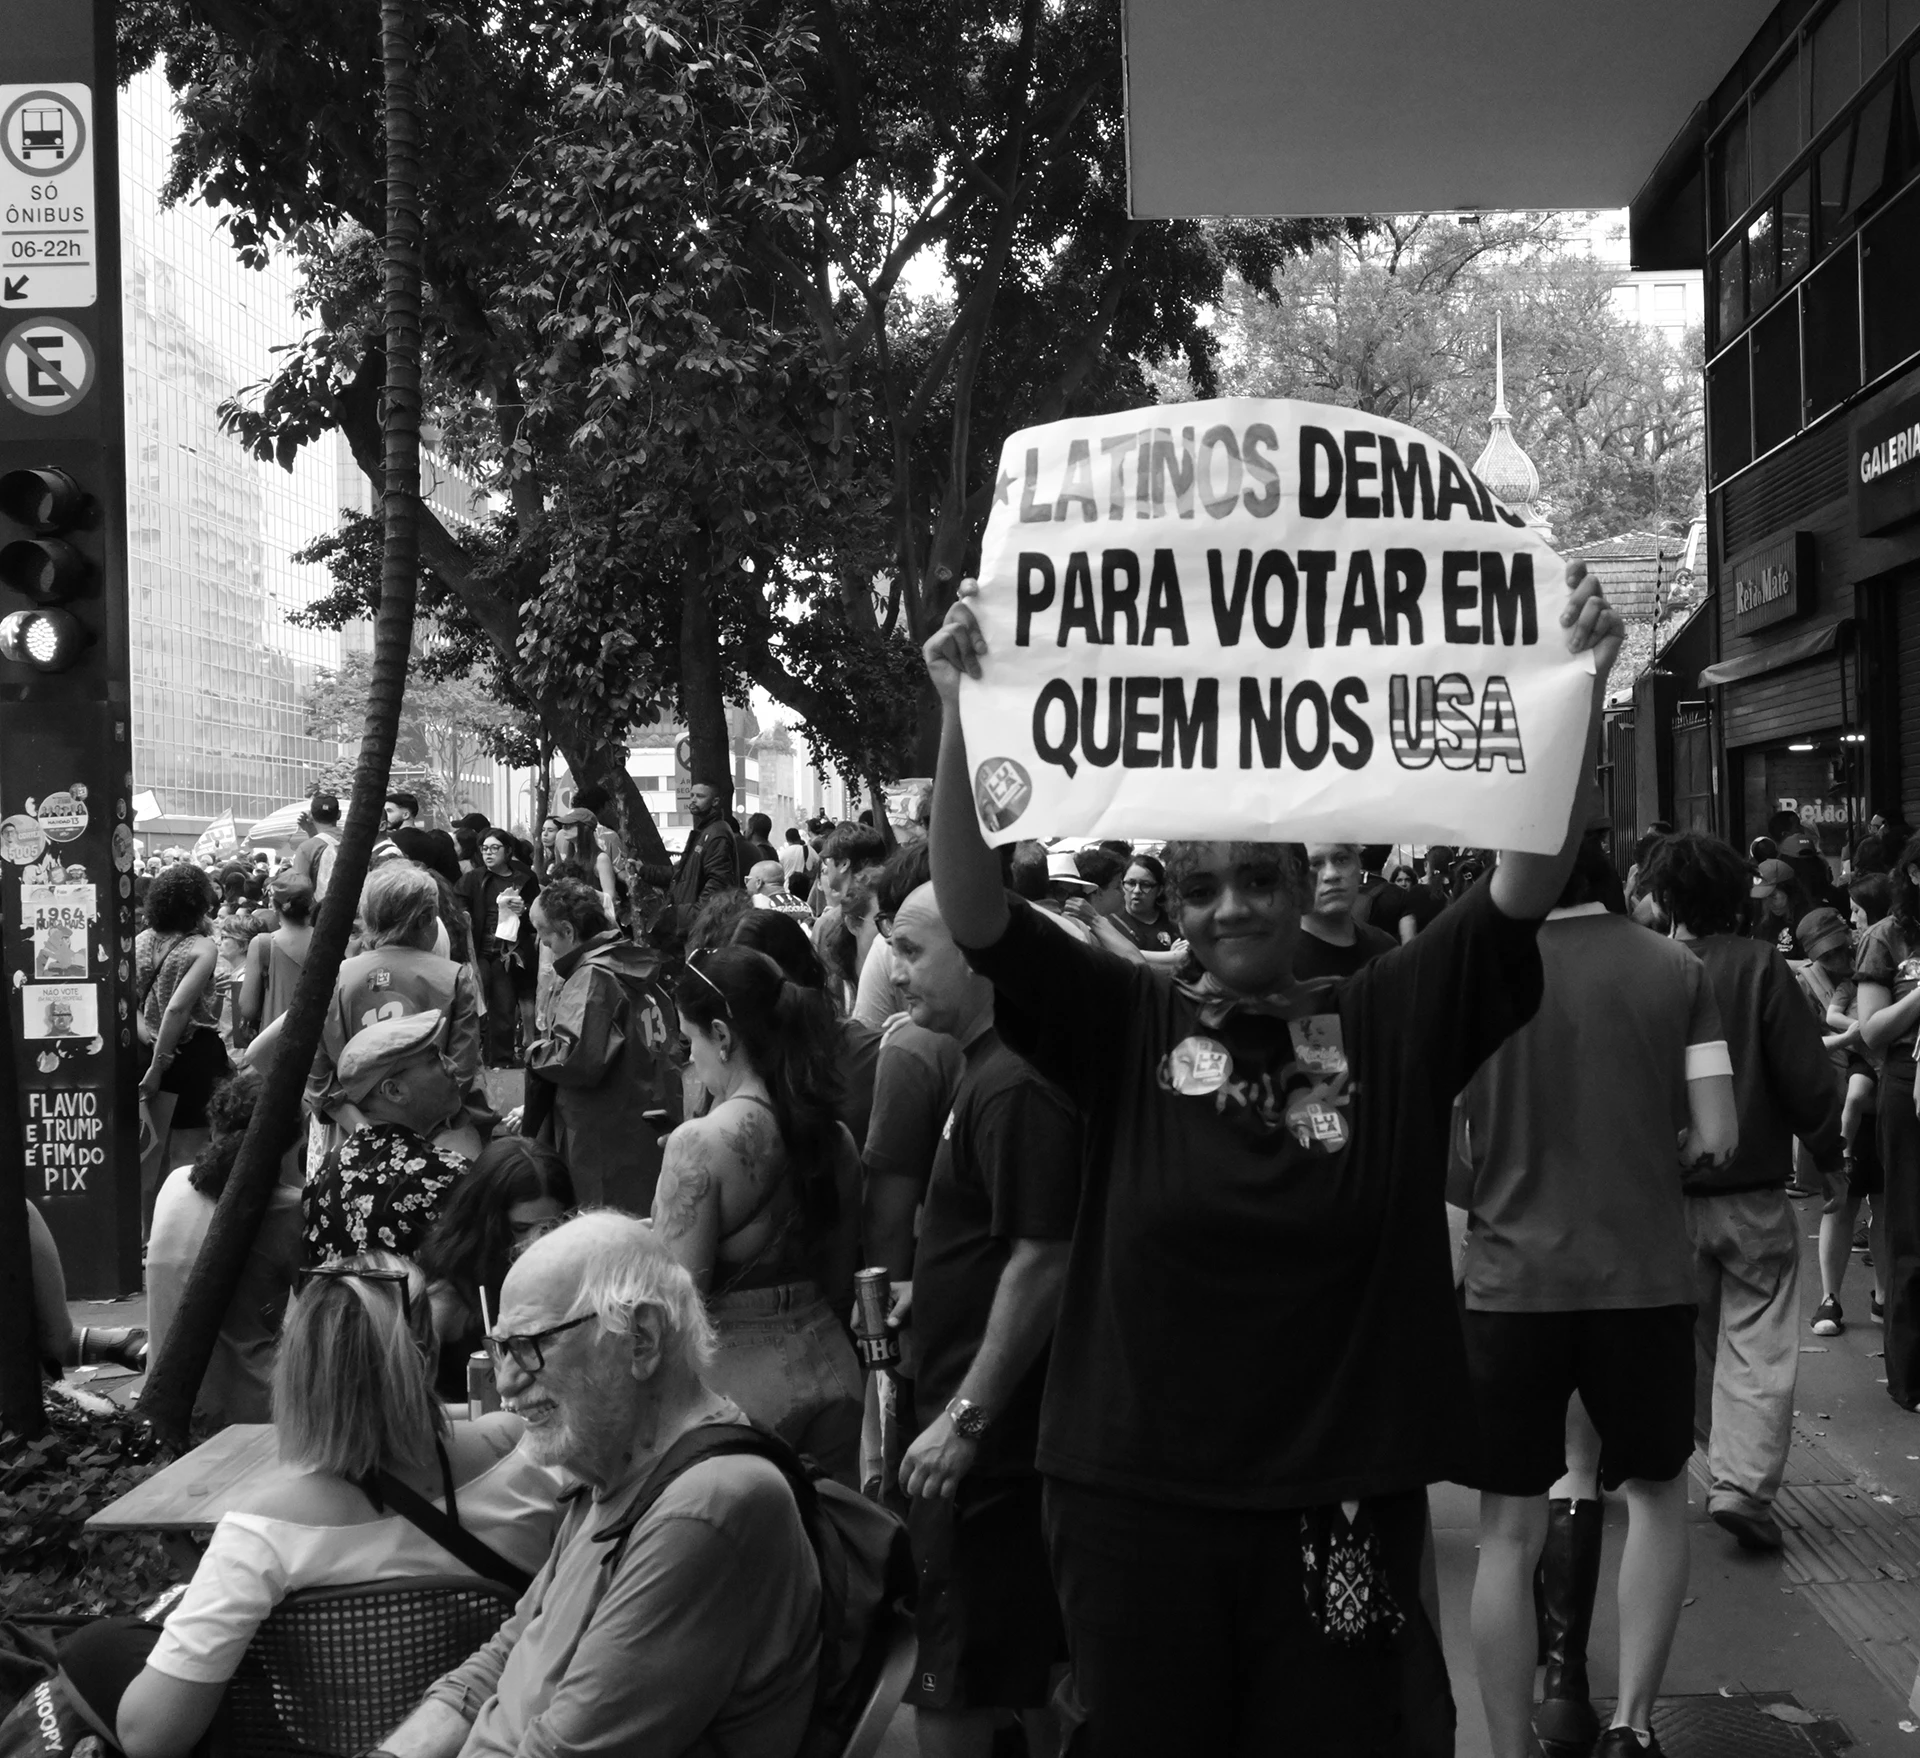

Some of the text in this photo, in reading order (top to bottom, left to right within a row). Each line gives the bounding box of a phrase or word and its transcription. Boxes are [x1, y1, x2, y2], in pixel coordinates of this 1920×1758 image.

[30, 180, 58, 201] SÓ
[5, 204, 85, 224] ÔNIBUS
[11, 240, 81, 258] 06-22h
[1861, 422, 1920, 484] GALERIA
[1019, 422, 1527, 528] LATINOS DEMAI
[1762, 563, 1789, 604] Mate
[1014, 547, 1539, 649] PARA VOTAR EM
[1032, 673, 1526, 779] QUEM NOS USA
[9, 845, 38, 860] 5005
[36, 907, 84, 921] 1964
[60, 987, 79, 996] VOTE
[640, 1005, 667, 1048] 13
[29, 1092, 97, 1118] FLAVIO
[26, 1118, 103, 1142] E TRUMP
[25, 1143, 105, 1166] É FIM DO
[45, 1167, 88, 1191] PIX
[34, 1682, 64, 1751] SNOOPY
